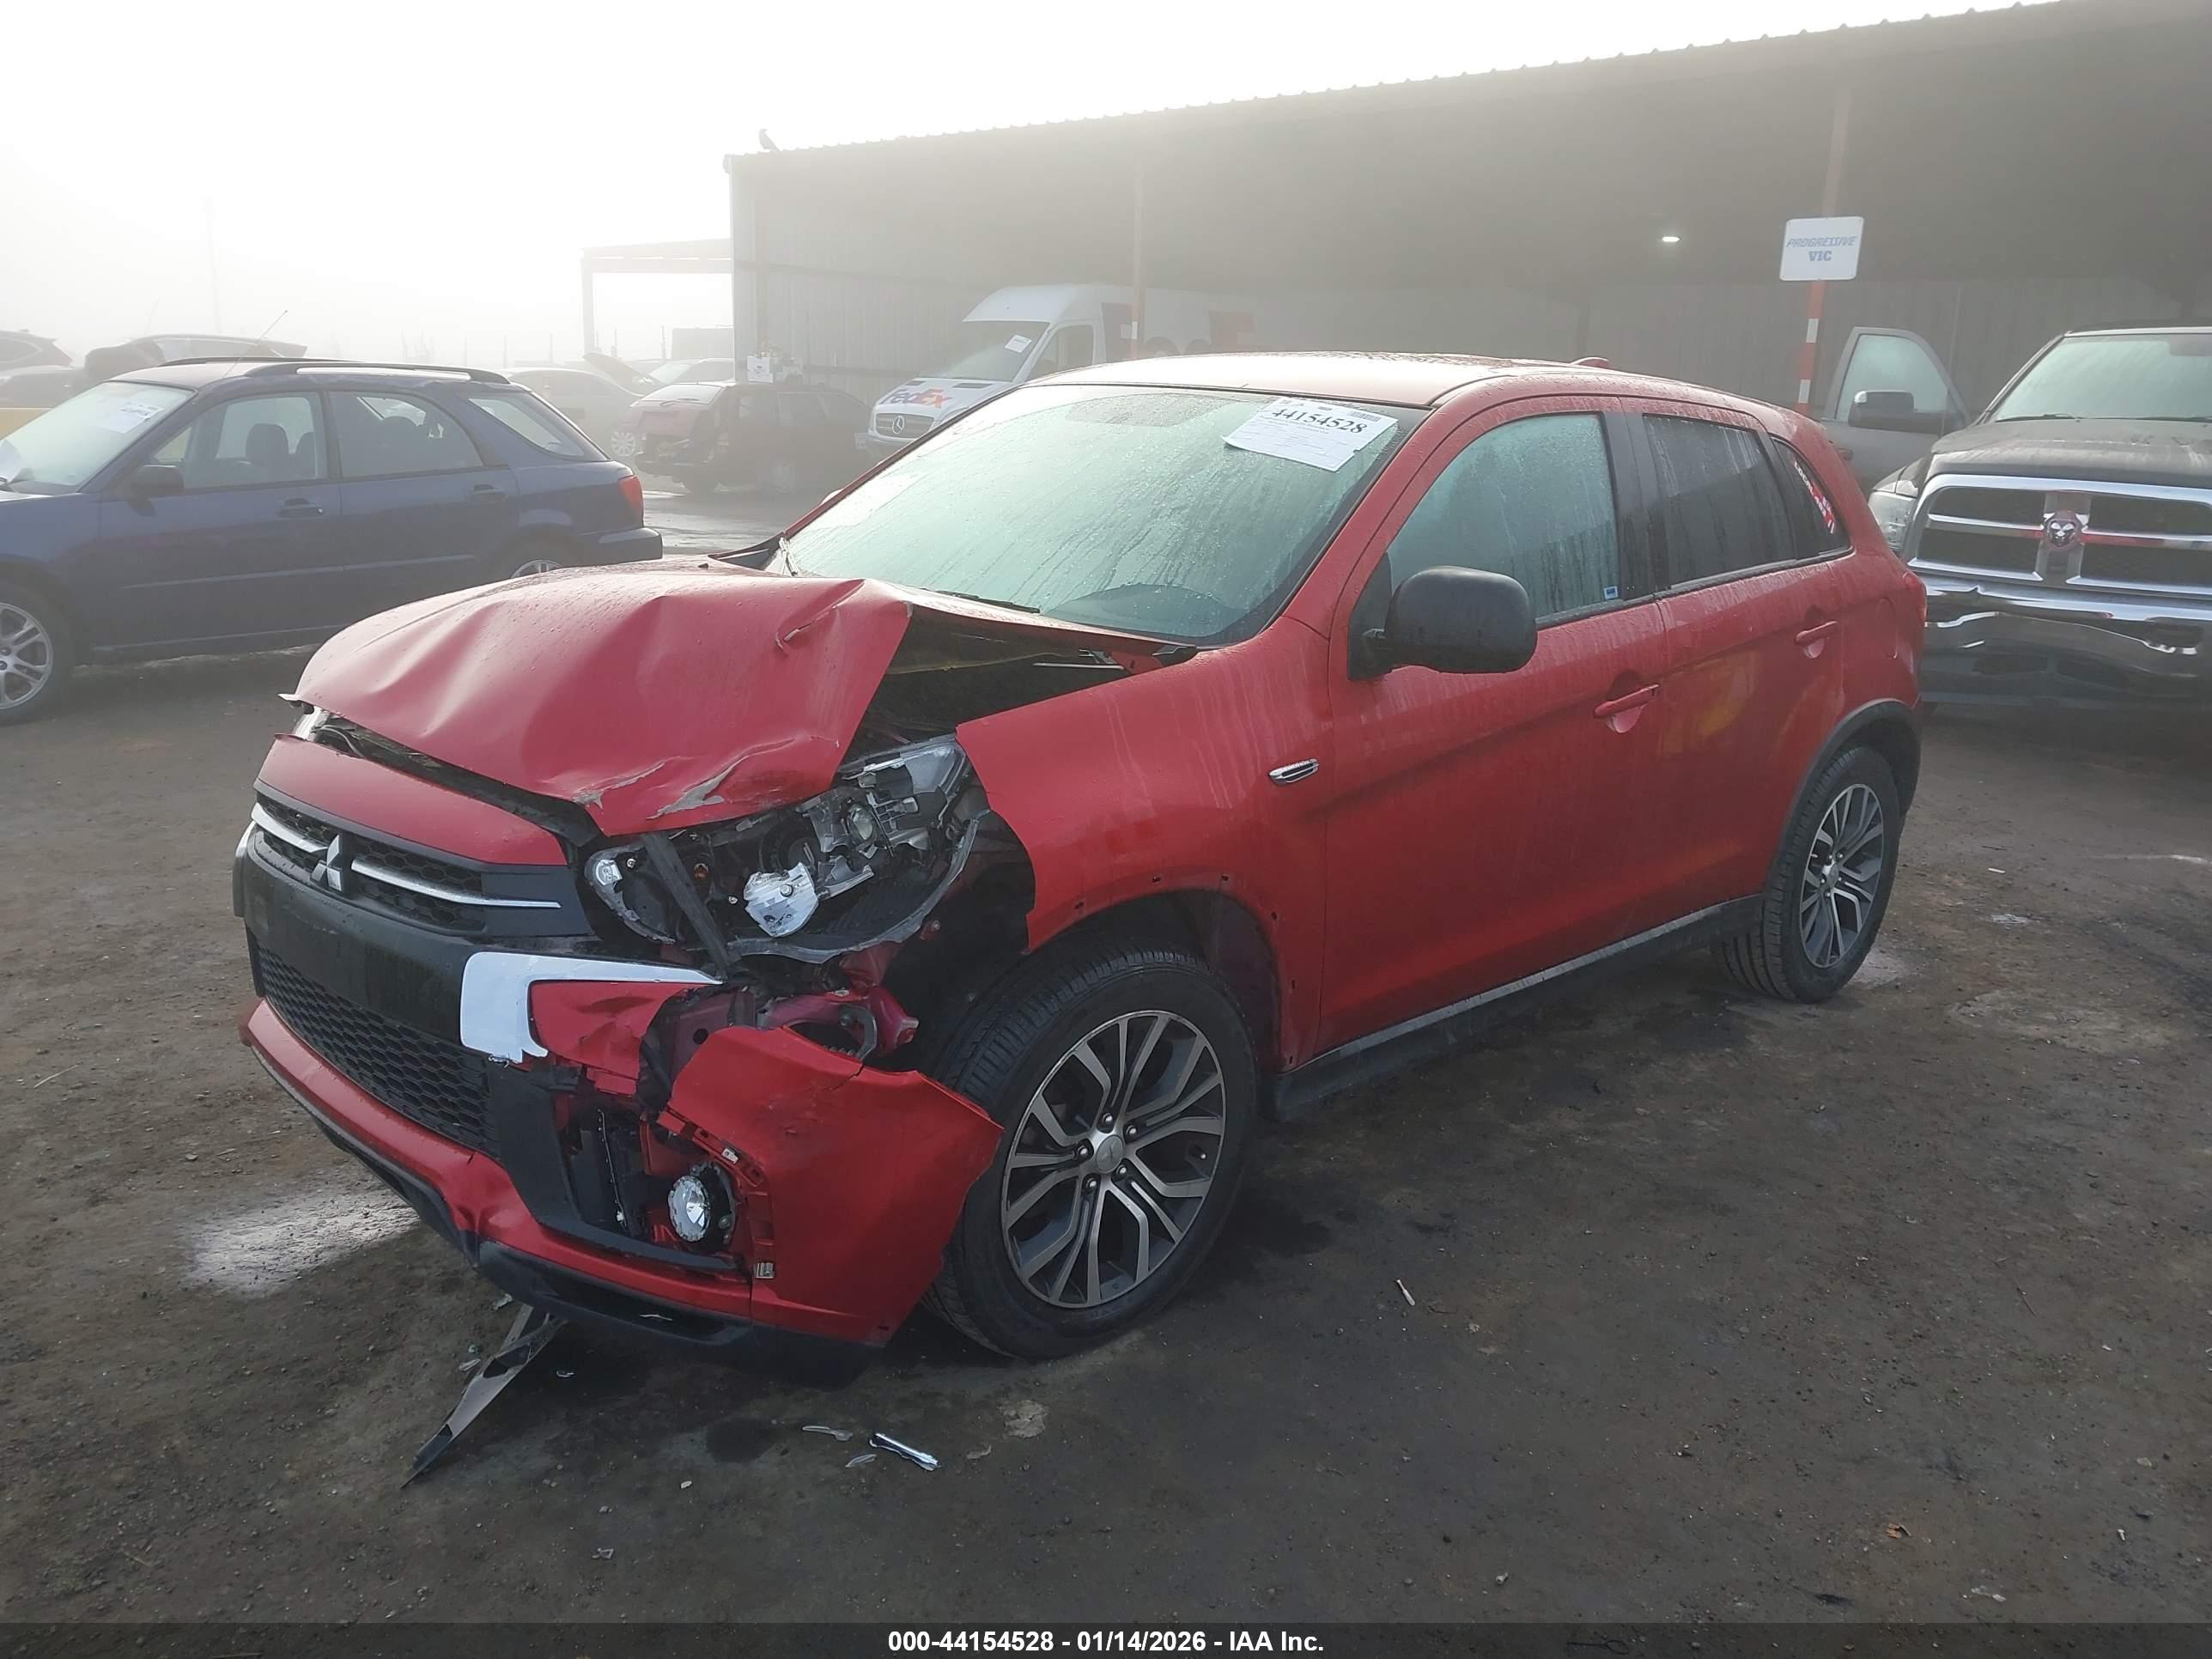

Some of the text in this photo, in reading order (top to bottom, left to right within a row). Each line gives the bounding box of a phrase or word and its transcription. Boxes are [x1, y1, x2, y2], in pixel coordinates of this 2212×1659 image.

[1786, 236, 1858, 248] PROGRESSIVE
[1808, 250, 1832, 262] VIC
[879, 387, 953, 409] FedEx
[1273, 408, 1368, 434] 44154528
